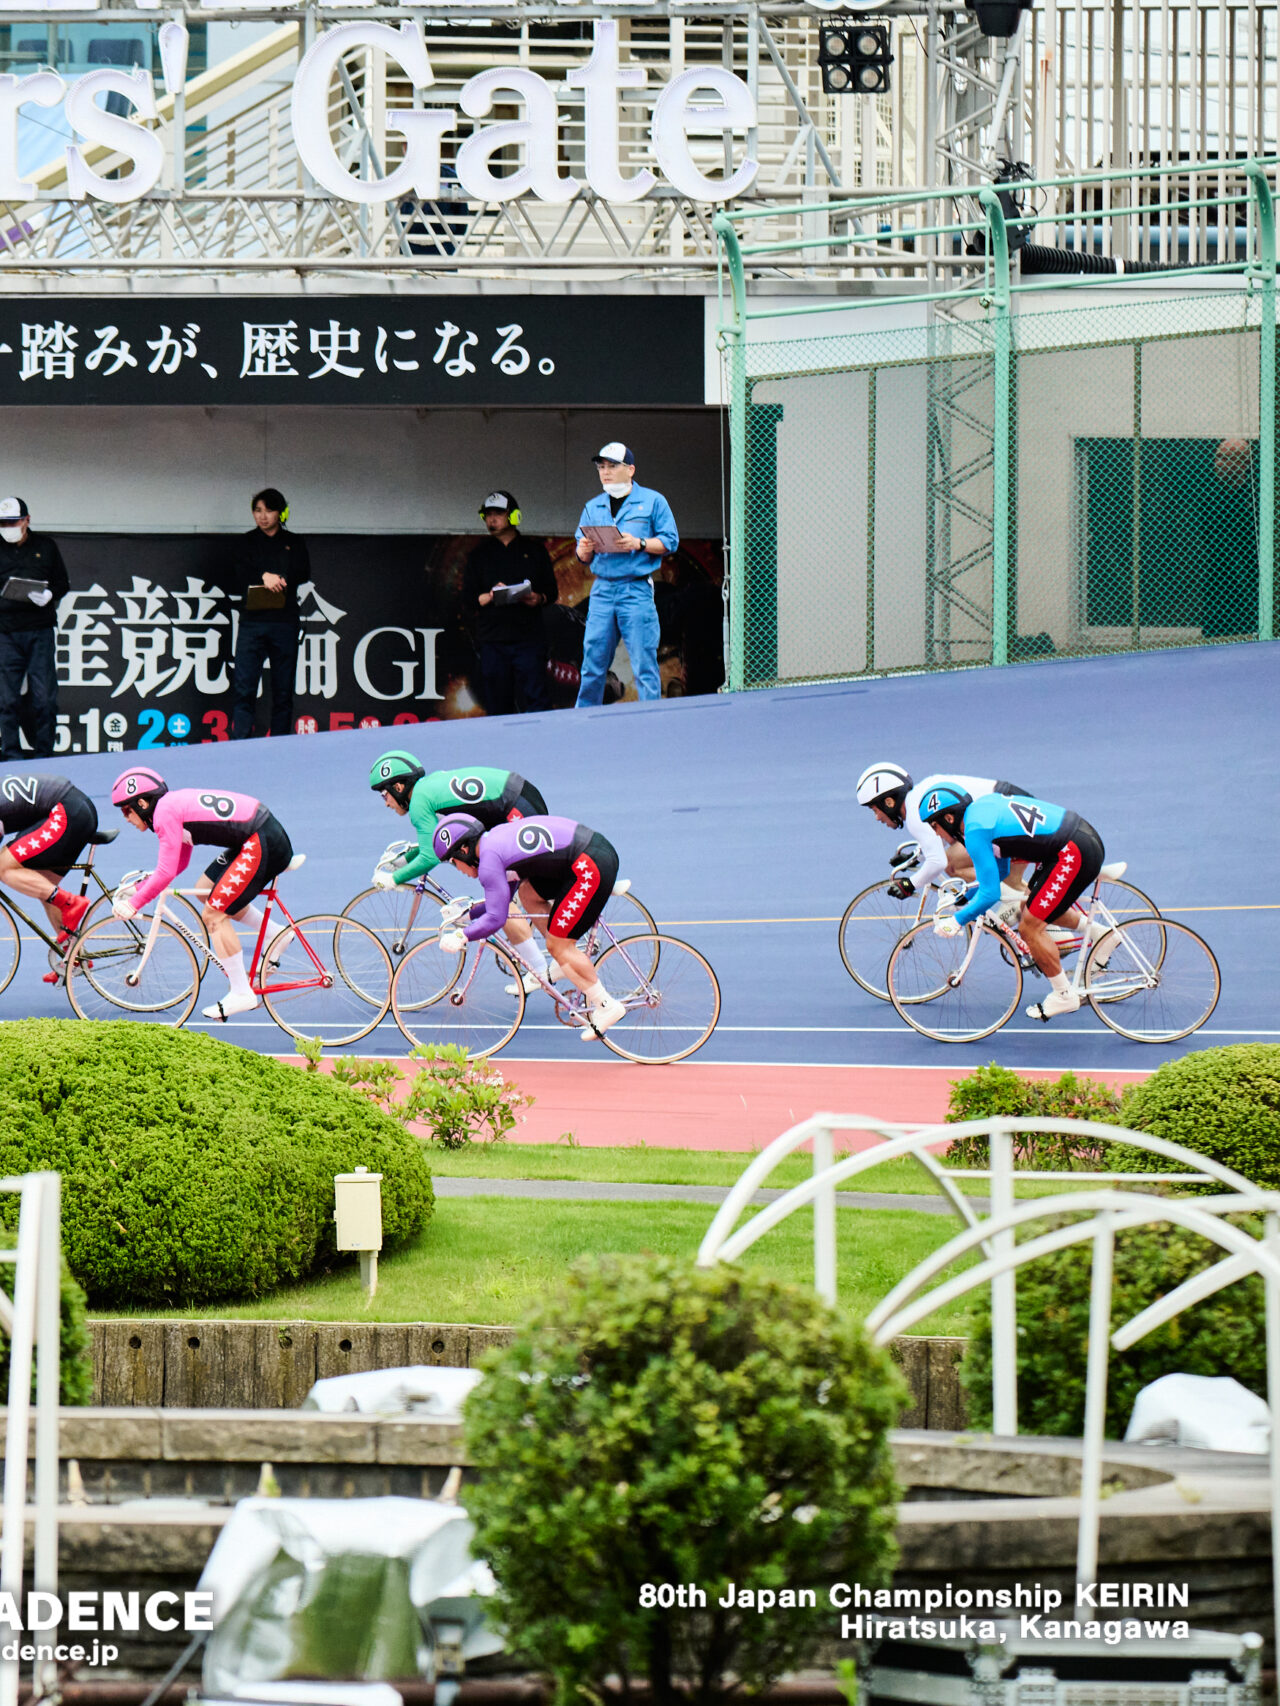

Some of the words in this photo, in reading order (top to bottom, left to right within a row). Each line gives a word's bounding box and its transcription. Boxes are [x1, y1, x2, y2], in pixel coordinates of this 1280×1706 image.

[291, 20, 760, 204] Gate
[137, 709, 165, 750] 2
[172, 718, 186, 734] 土
[201, 710, 229, 743] 3
[380, 760, 391, 779] 6
[2, 776, 38, 805] 2
[126, 776, 137, 795] 8
[449, 776, 486, 804] 6
[872, 776, 879, 793] 1
[199, 793, 236, 820] 8
[928, 793, 940, 812] 4
[1008, 801, 1047, 838] 4
[439, 828, 450, 849] 9
[516, 823, 555, 854] 9
